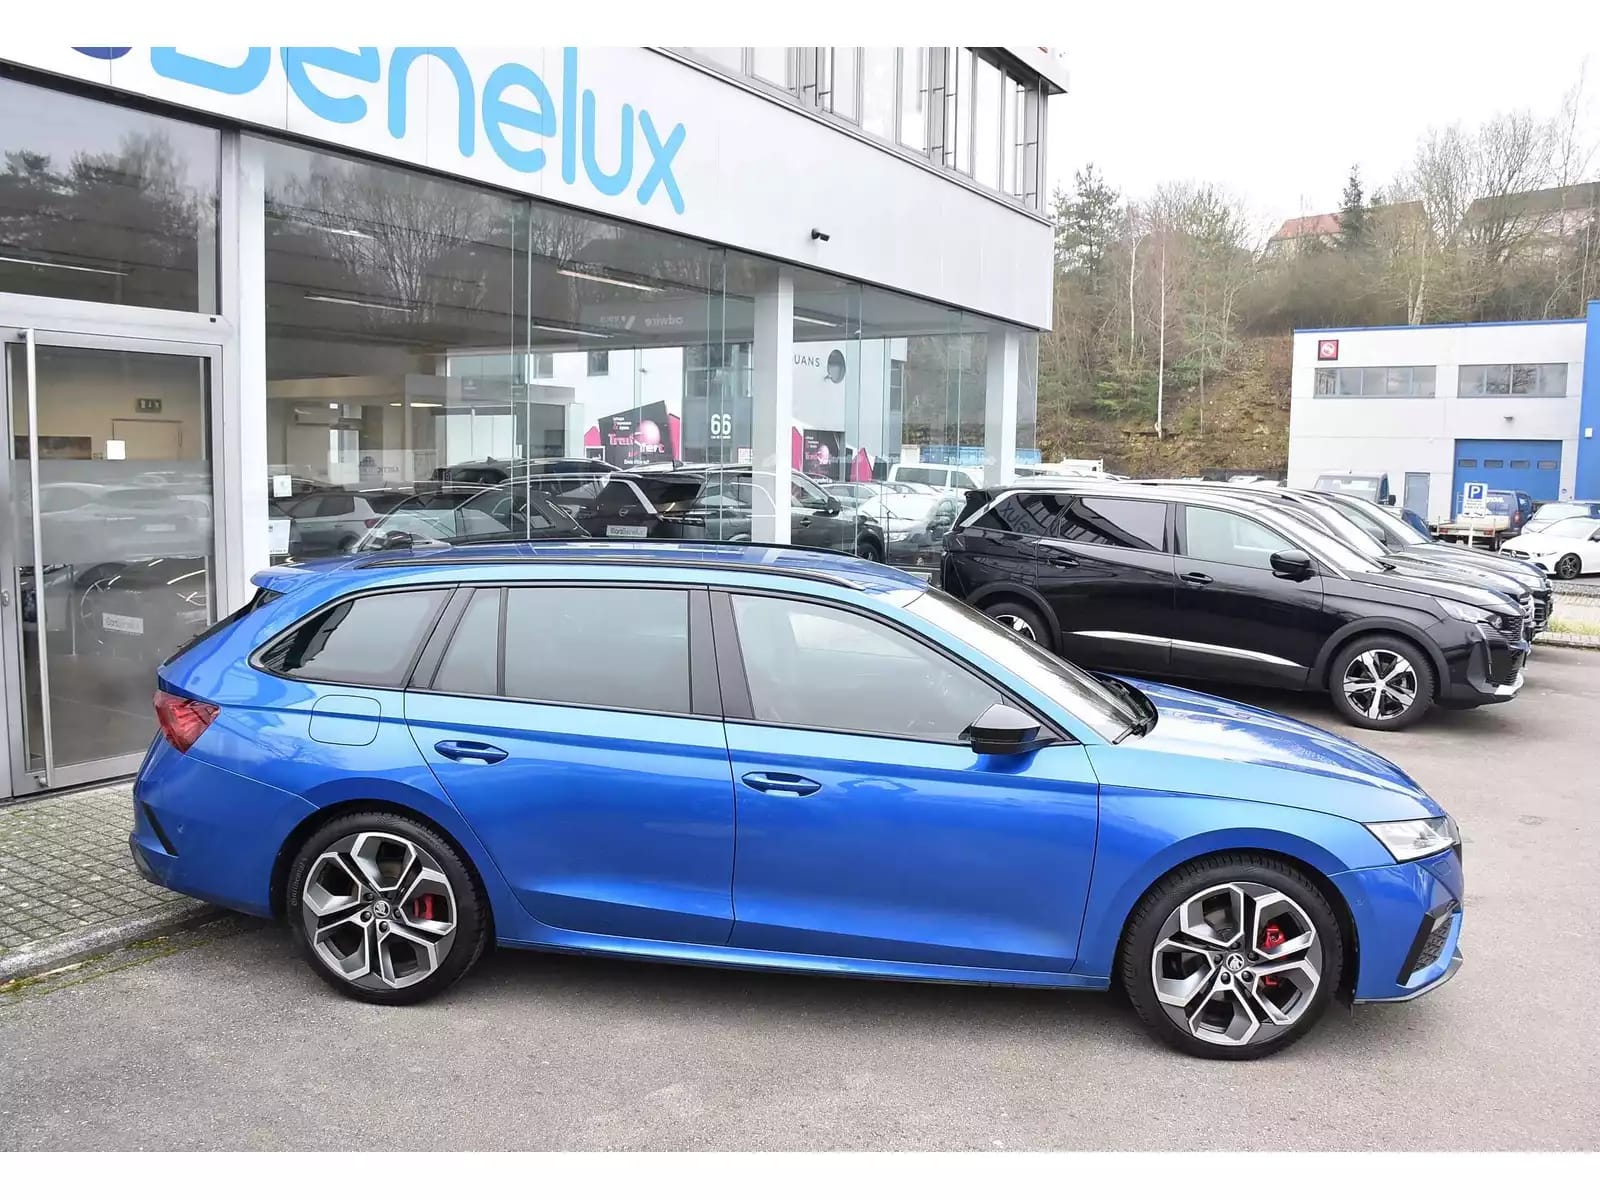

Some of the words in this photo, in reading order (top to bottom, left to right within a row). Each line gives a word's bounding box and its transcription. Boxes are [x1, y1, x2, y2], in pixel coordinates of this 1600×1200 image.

[150, 47, 686, 214] enelux
[711, 413, 732, 435] 66
[1470, 486, 1481, 499] P
